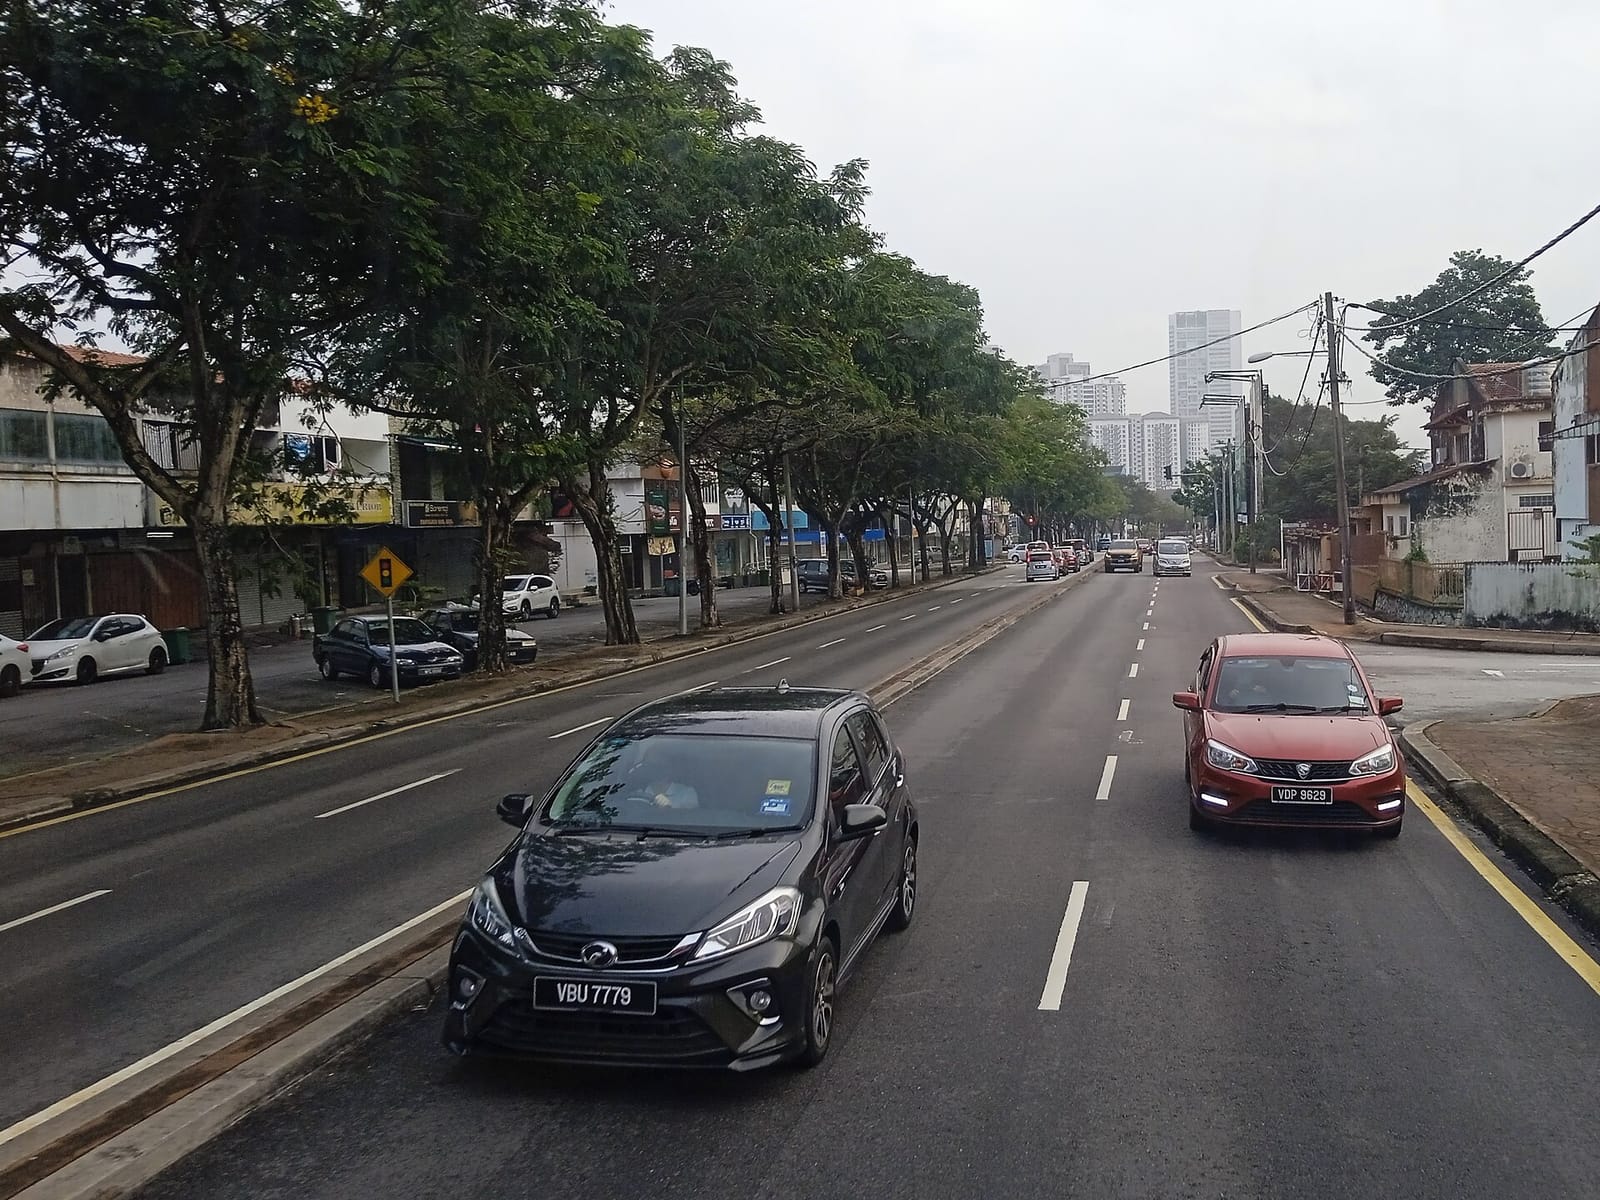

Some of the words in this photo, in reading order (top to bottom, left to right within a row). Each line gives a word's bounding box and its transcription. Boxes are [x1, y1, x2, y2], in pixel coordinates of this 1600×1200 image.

[1278, 788, 1298, 800] VDP
[1300, 789, 1326, 801] 9629
[556, 982, 589, 1003] VBU
[591, 985, 632, 1006] 7779
